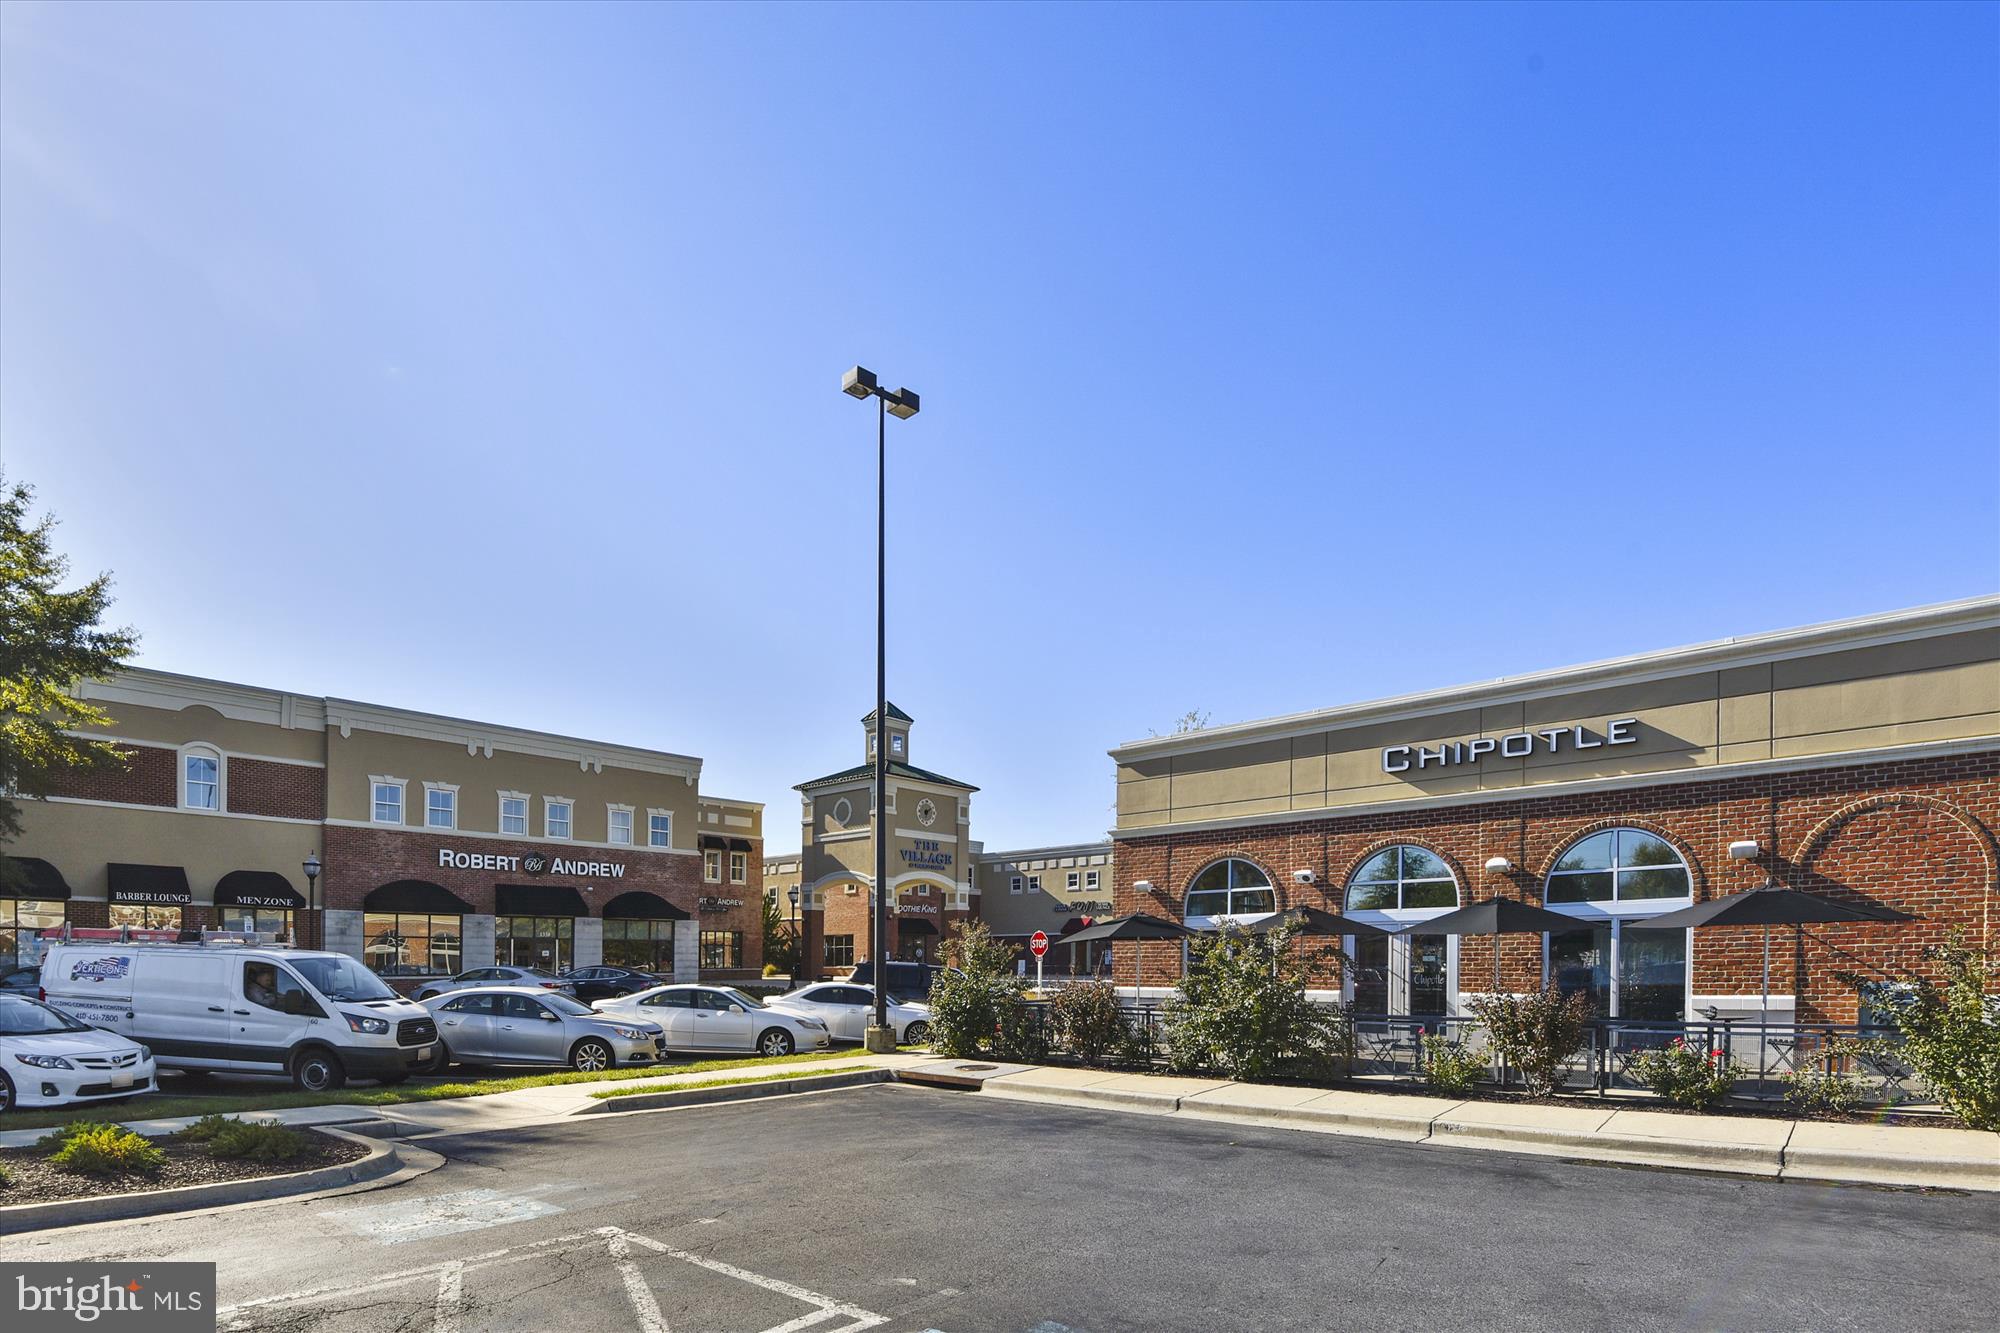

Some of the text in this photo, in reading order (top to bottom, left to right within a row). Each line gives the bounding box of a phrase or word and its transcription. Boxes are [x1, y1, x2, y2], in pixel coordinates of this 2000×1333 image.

[1382, 717, 1637, 773] CHIPOTLE
[900, 850, 952, 865] VILLAGE
[439, 849, 520, 872] ROBERT
[550, 857, 625, 878] ANDREW
[116, 891, 191, 903] BARBER LOUNGE
[236, 895, 294, 906] MEN ZONE
[717, 897, 744, 906] ANDREW
[921, 904, 937, 913] KING
[1032, 939, 1047, 949] STOP
